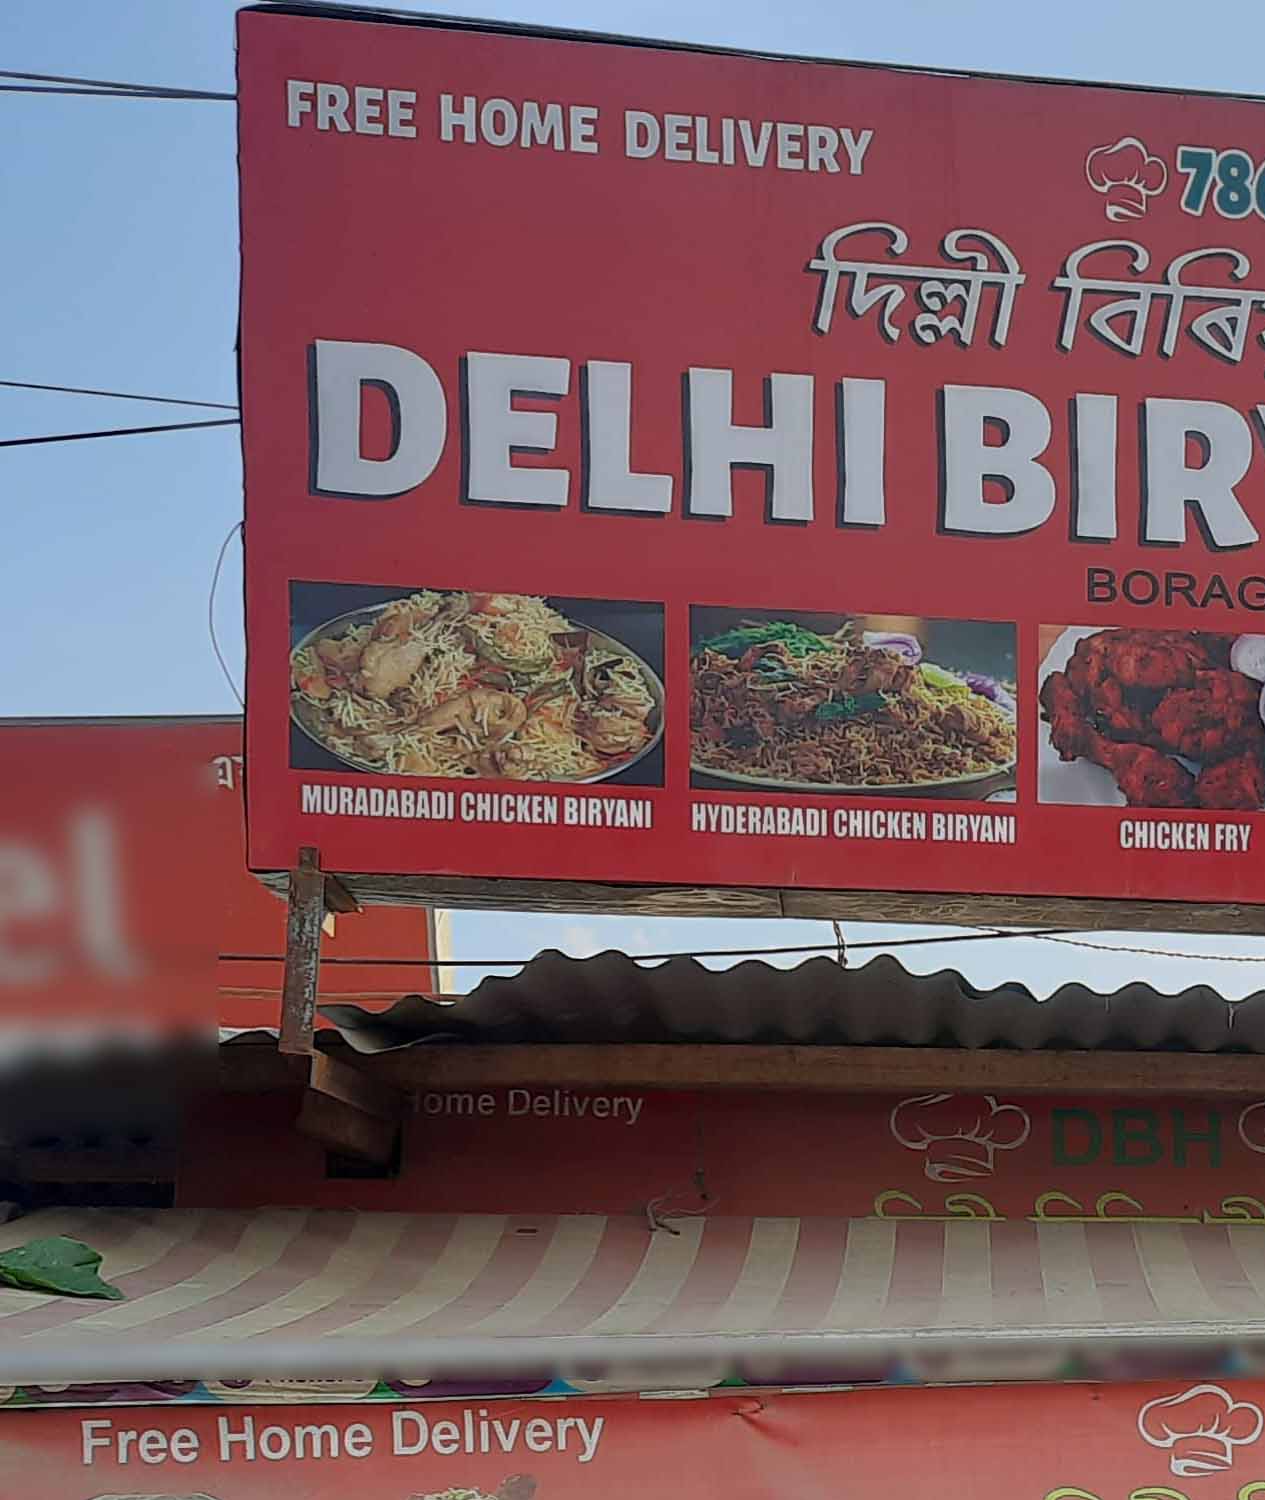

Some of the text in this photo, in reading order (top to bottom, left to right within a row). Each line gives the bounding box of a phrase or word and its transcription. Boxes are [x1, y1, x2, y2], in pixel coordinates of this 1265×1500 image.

[286, 78, 873, 175] FREE HOME DELIVERY
[803, 221, 1026, 348] দিল্লী
[307, 338, 888, 529] DELHI
[301, 784, 653, 829] MURADABADI CHICKEN BIRYANI
[691, 803, 1016, 844] HYDERABADI CHICKEN BIRYANI
[1118, 820, 1252, 854] CHICKEN FRY
[508, 1089, 643, 1124] Delivery
[1052, 1109, 1220, 1168] DBH
[81, 1407, 605, 1465] Free Home Delivery
